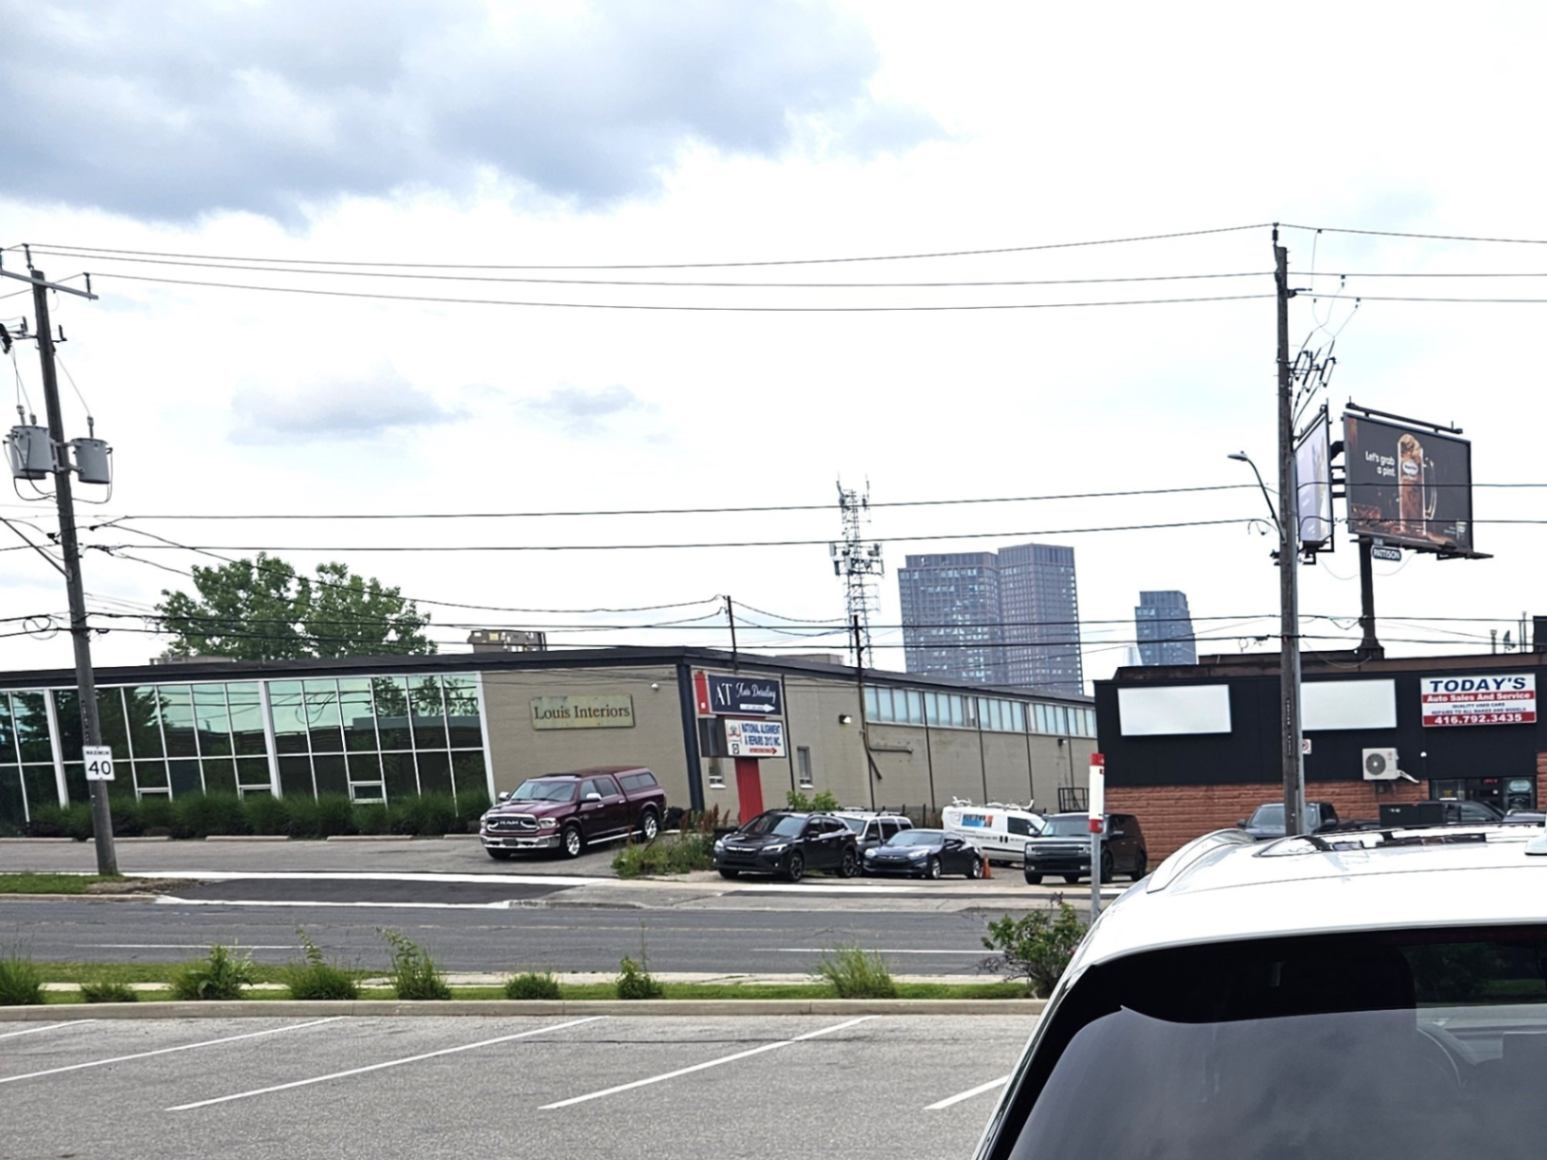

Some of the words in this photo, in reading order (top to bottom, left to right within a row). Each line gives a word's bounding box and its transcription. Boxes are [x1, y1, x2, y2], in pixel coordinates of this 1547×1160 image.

[1373, 549, 1400, 559] PATTISON
[1429, 677, 1526, 692] TODAY'S
[1497, 692, 1530, 700] Service
[534, 705, 570, 720] Louis
[574, 704, 631, 719] Interiors
[1434, 713, 1522, 724] 416.792.3435
[88, 760, 112, 775] 40
